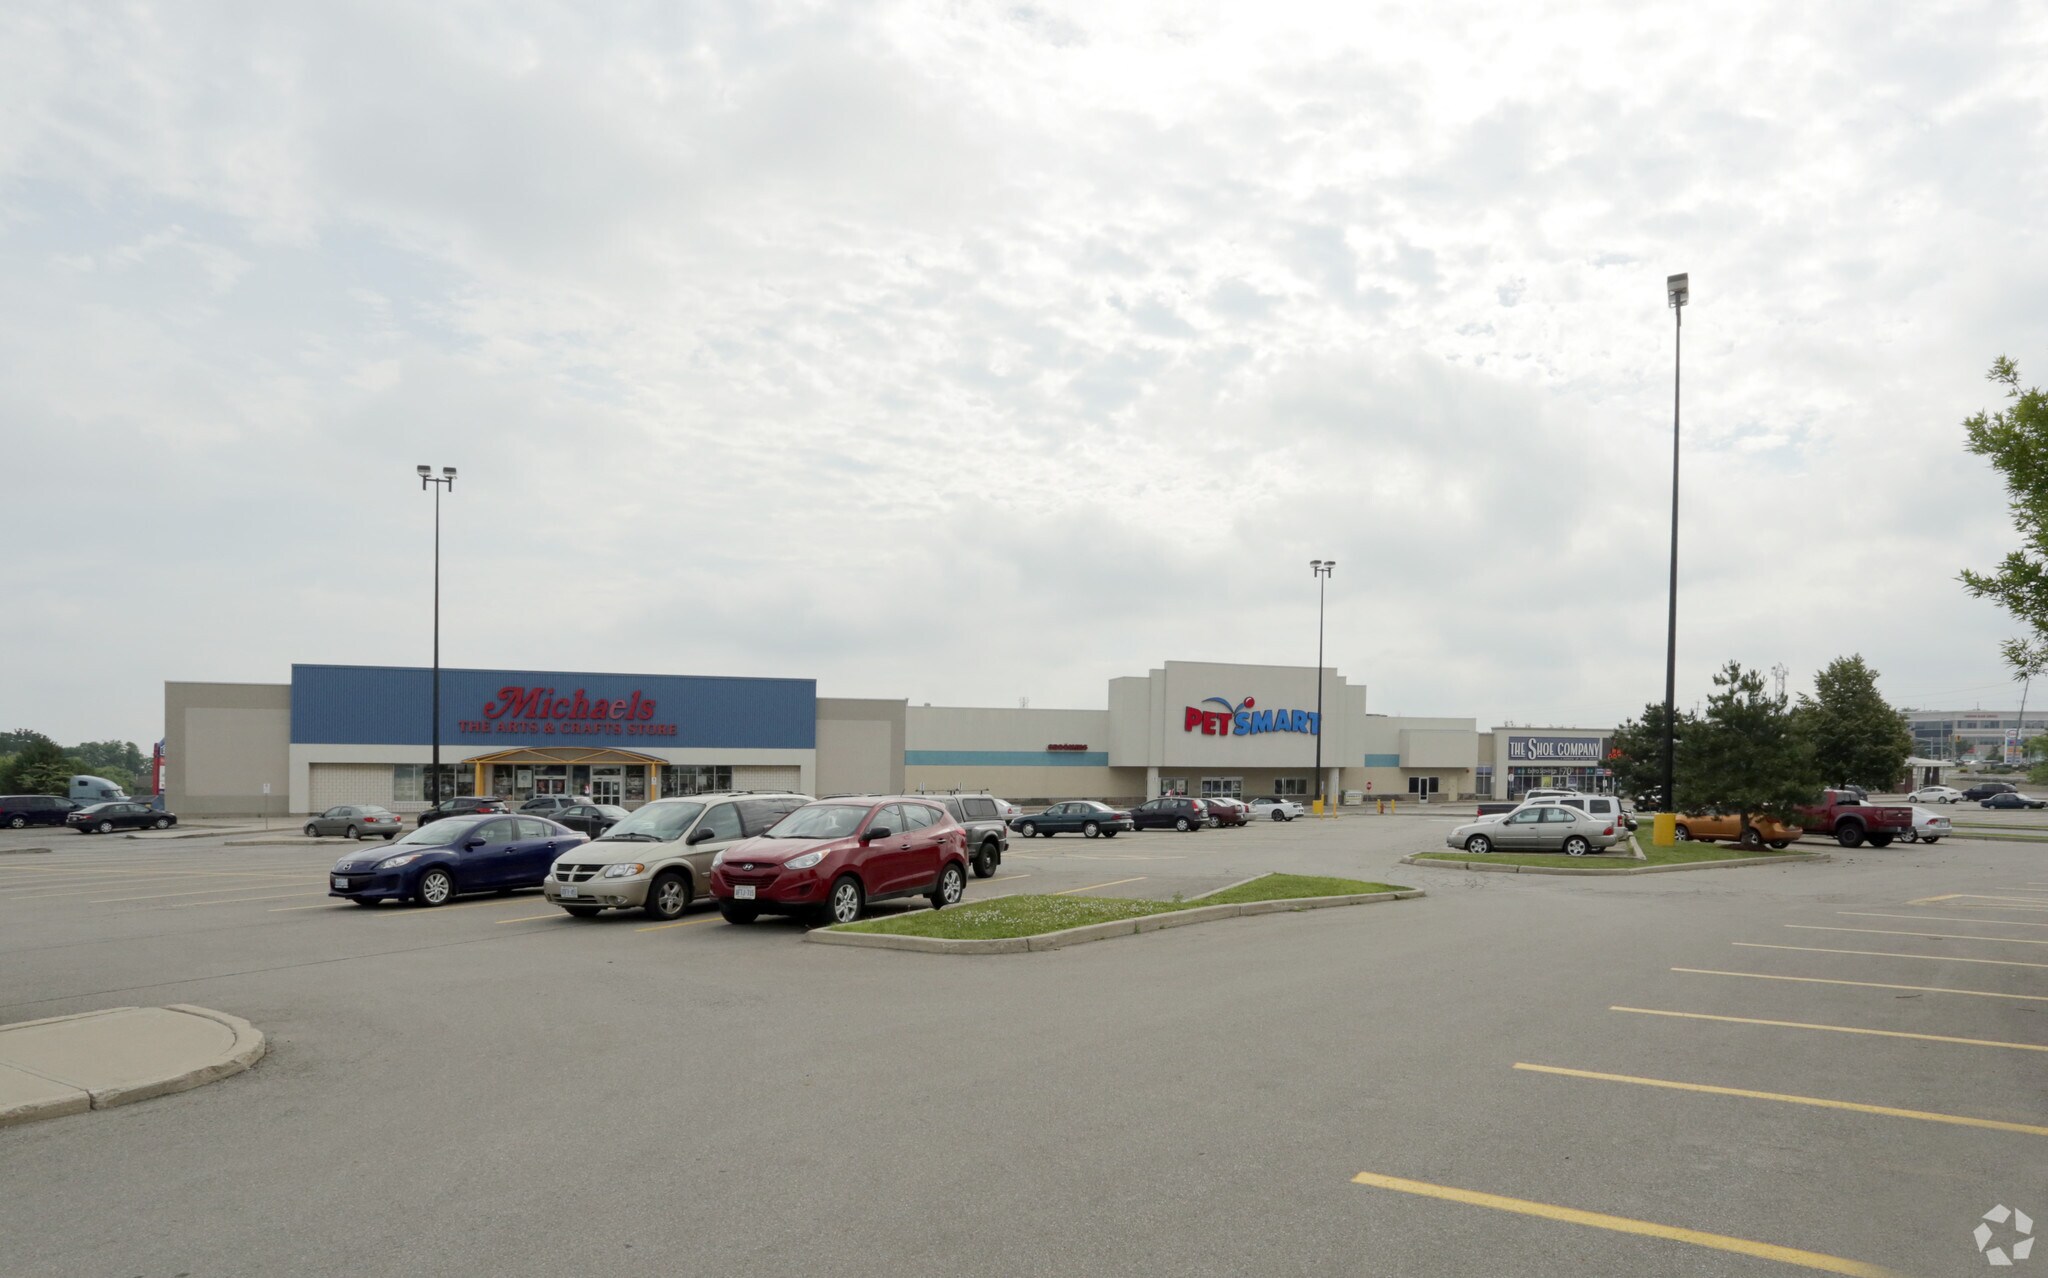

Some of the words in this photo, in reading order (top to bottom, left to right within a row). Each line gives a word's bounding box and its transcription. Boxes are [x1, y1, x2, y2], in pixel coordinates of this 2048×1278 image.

[483, 686, 657, 721] Michaels
[458, 720, 491, 734] THE
[496, 720, 539, 734] ARTS
[543, 721, 556, 734] &
[560, 721, 622, 735] CRAFTS
[626, 722, 678, 736] STORE
[1509, 742, 1526, 756] THE
[1557, 742, 1600, 756] COMPANY
